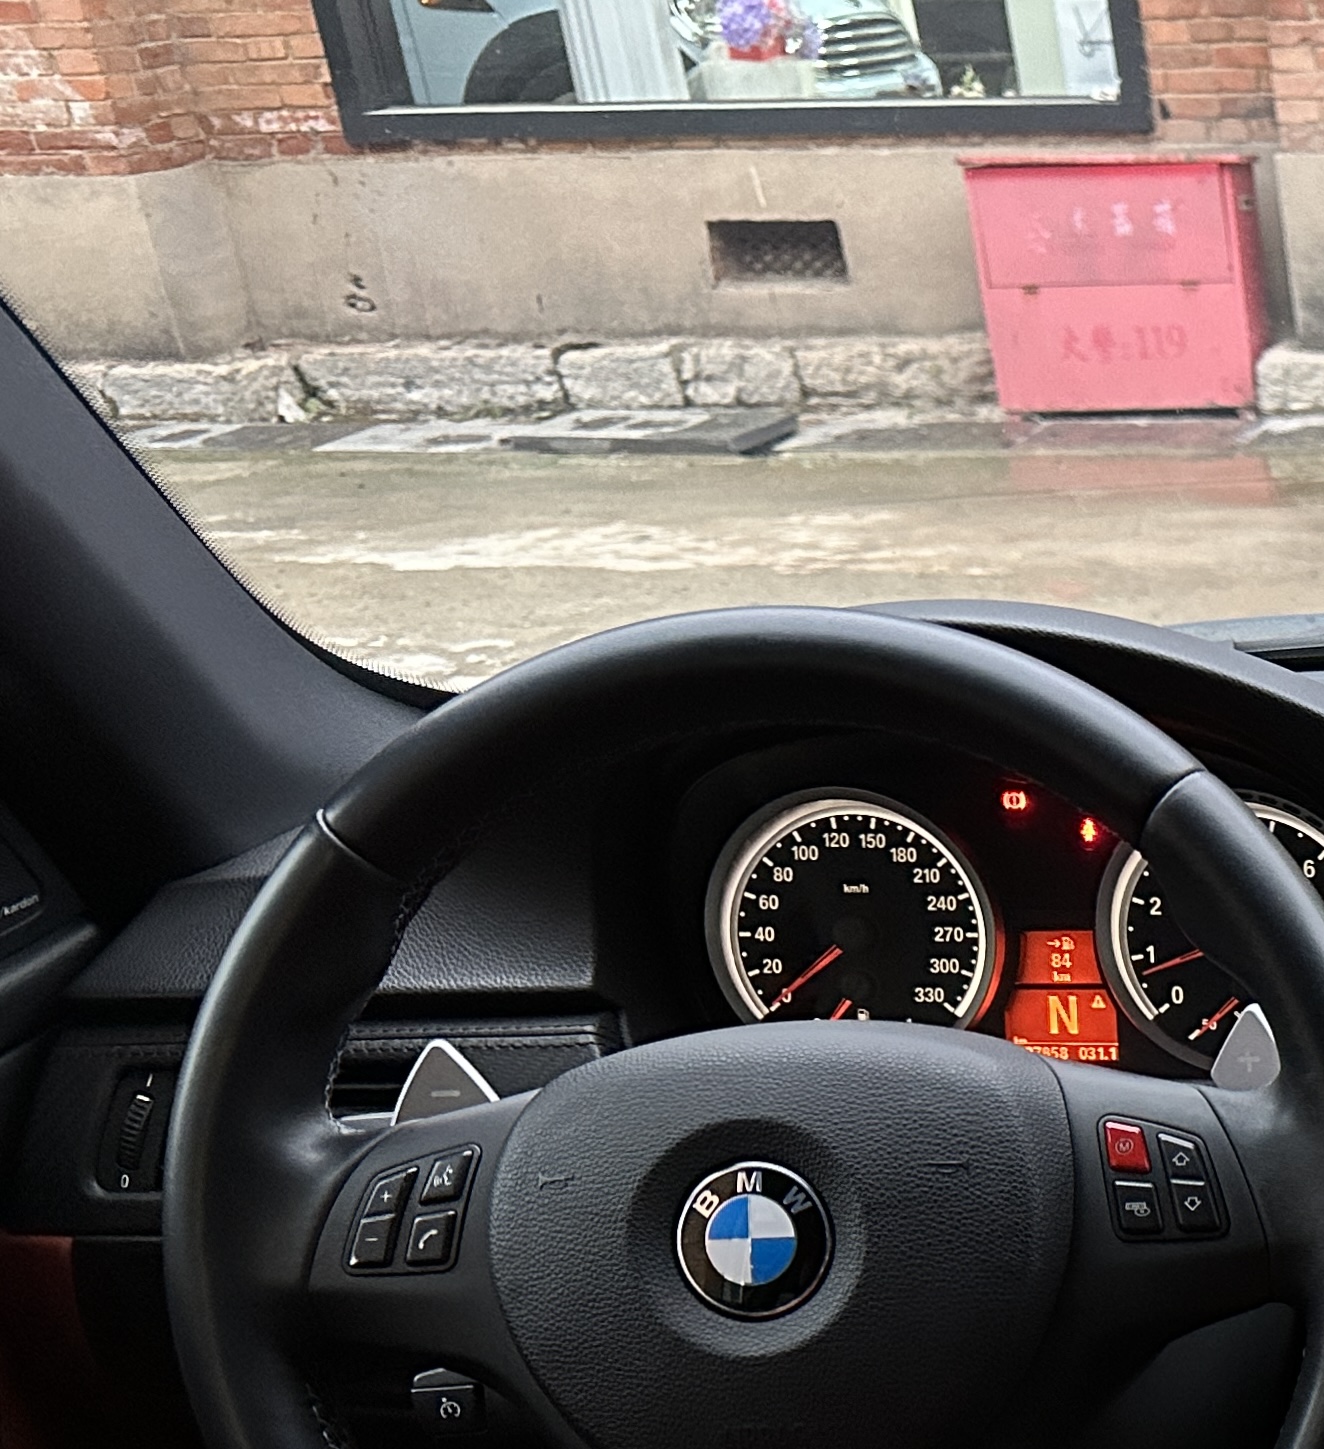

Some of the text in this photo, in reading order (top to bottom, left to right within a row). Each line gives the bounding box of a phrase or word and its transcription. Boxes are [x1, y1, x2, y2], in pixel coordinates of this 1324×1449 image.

[823, 833, 850, 847] 120
[859, 834, 886, 848] 150
[792, 846, 819, 860] 100
[890, 848, 917, 862] 180
[773, 867, 793, 882] 80
[1303, 859, 1316, 878] 6
[913, 869, 940, 883] 210
[843, 884, 869, 893] km/h
[759, 895, 779, 910] 60
[927, 897, 957, 911] 240
[1150, 897, 1162, 915] 2
[754, 926, 775, 941] 40
[934, 928, 964, 942] 270
[1051, 953, 1072, 968] 84
[1146, 946, 1155, 963] 1
[762, 959, 782, 973] 20
[929, 959, 959, 973] 300
[914, 988, 944, 1002] 330
[1171, 986, 1184, 1004] 0
[1047, 995, 1079, 1035] N
[1079, 1046, 1117, 1060] 031.1
[692, 1171, 813, 1219] BMW
